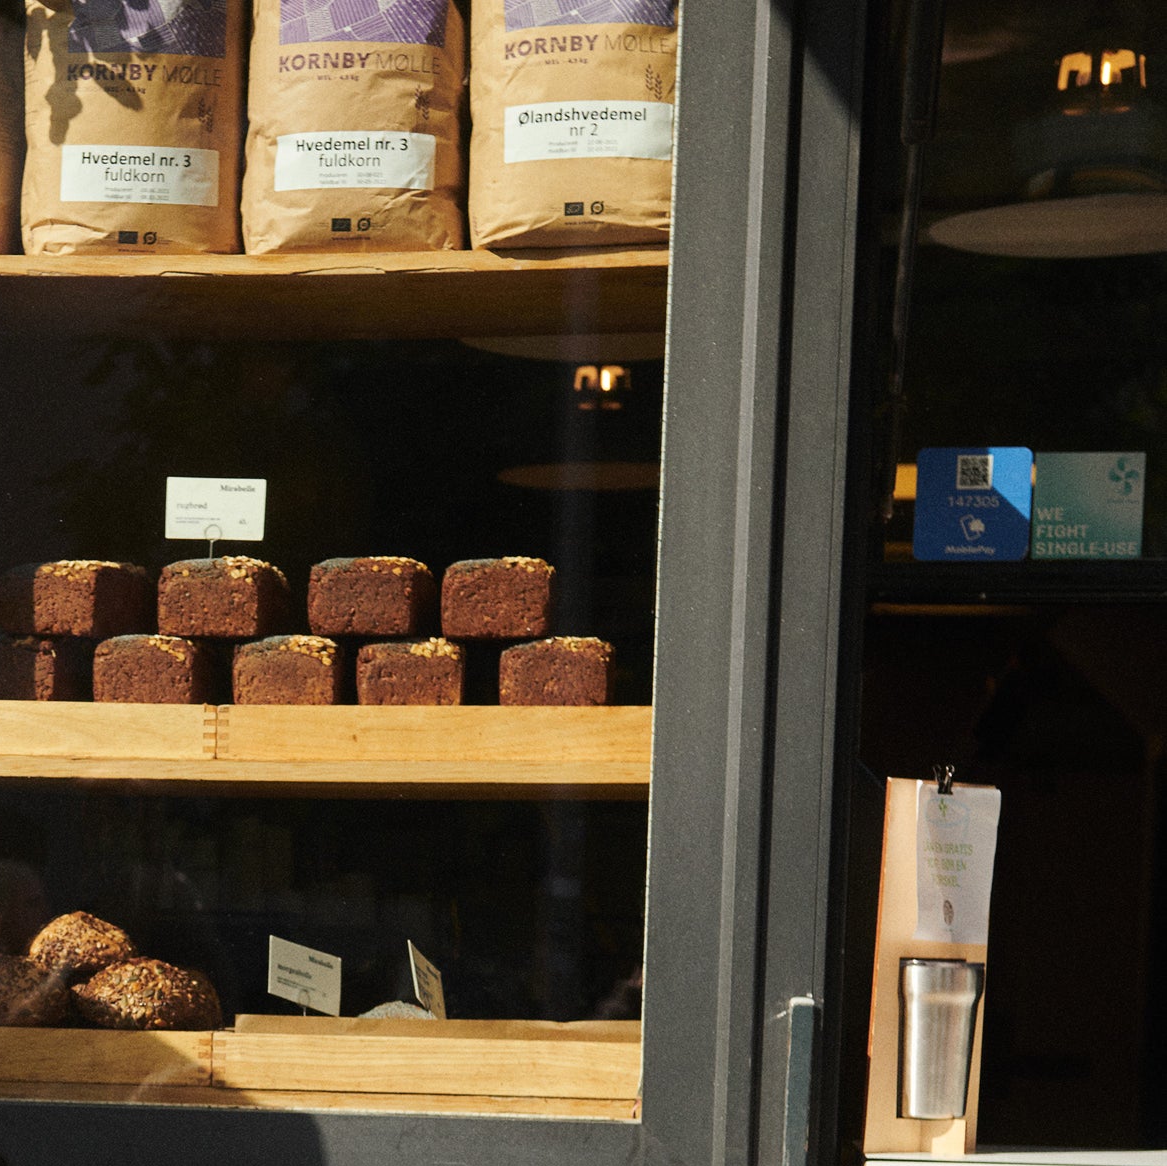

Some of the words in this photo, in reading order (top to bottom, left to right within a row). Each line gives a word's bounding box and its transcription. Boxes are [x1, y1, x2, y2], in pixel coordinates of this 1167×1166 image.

[505, 34, 598, 60] KORNBY
[605, 34, 671, 53] MØLLE
[279, 52, 370, 73] KORNBY
[377, 53, 441, 75] MØLLE
[67, 64, 157, 81] KORNBY
[163, 65, 221, 87] MØLLE
[518, 108, 647, 127] Ølandshvedemel
[570, 126, 584, 136] nr
[590, 123, 598, 136] 2
[296, 137, 370, 152] Hvedemel
[375, 140, 395, 151] nr.
[400, 138, 409, 151] 3
[82, 152, 155, 166] Hvedemel
[160, 156, 179, 167] nr.
[183, 155, 191, 167] 3
[319, 154, 381, 167] fuldkorn
[104, 168, 165, 183] fuldkorn
[1036, 507, 1064, 521] WE
[1036, 525, 1088, 538] FIGHT
[1035, 542, 1138, 556] SINGLE-USE
